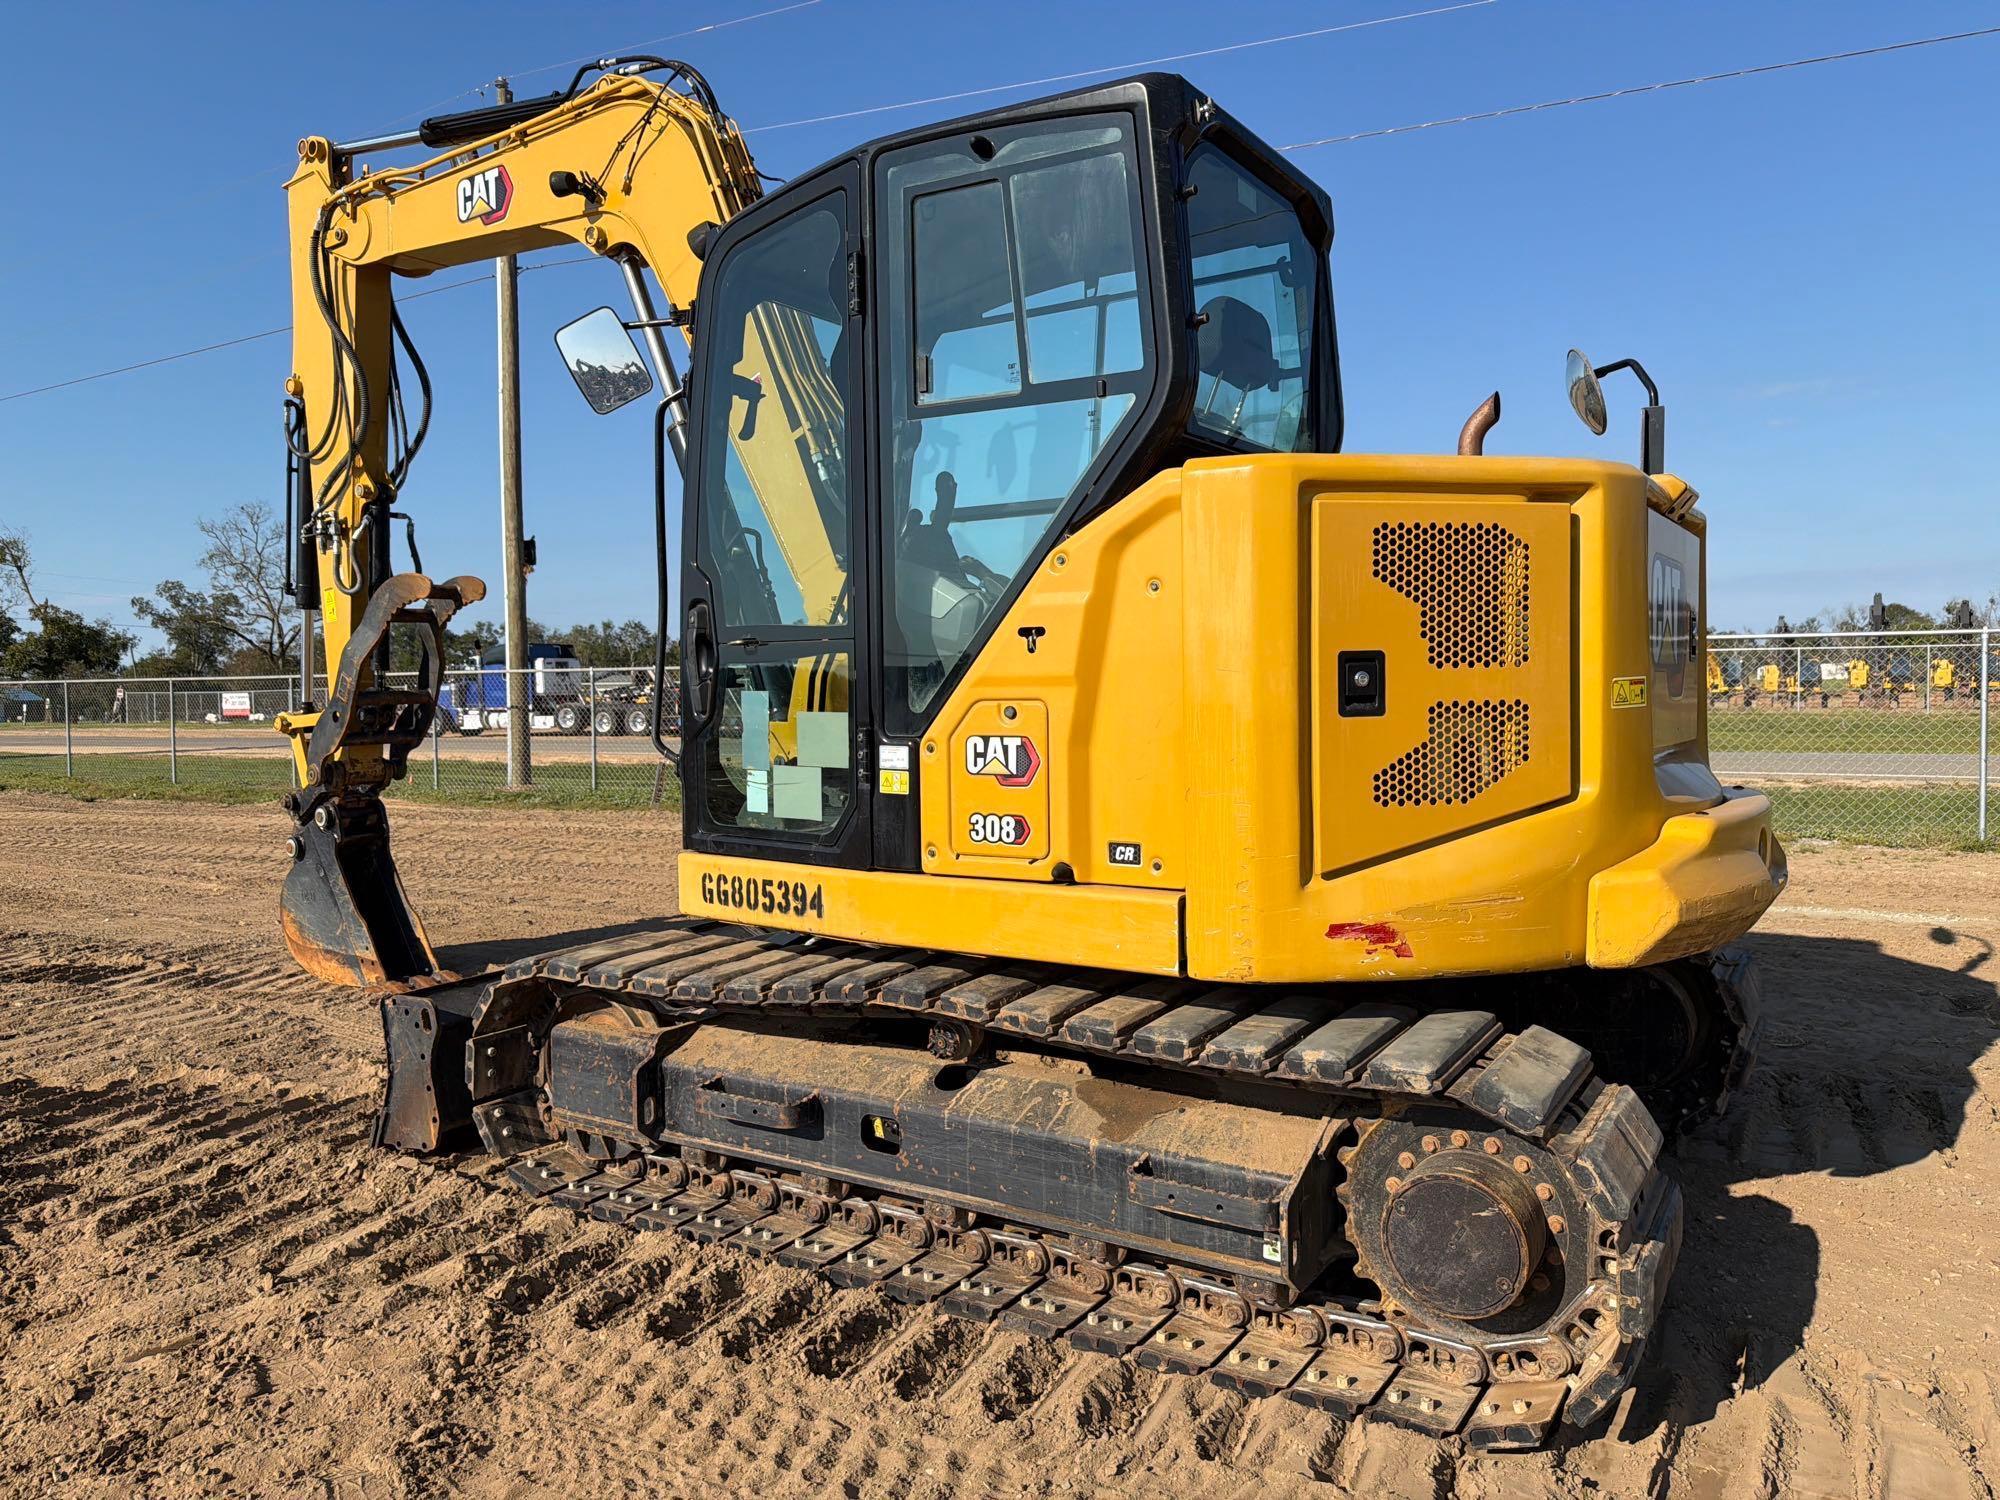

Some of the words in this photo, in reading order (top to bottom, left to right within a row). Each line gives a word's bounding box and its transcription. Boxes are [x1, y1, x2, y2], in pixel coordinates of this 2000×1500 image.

[458, 168, 498, 221] CAT
[1653, 560, 1681, 664] CAT
[966, 736, 1021, 775] CAT
[970, 814, 1016, 843] 308
[1115, 846, 1135, 861] CR
[701, 872, 824, 919] GG805394
